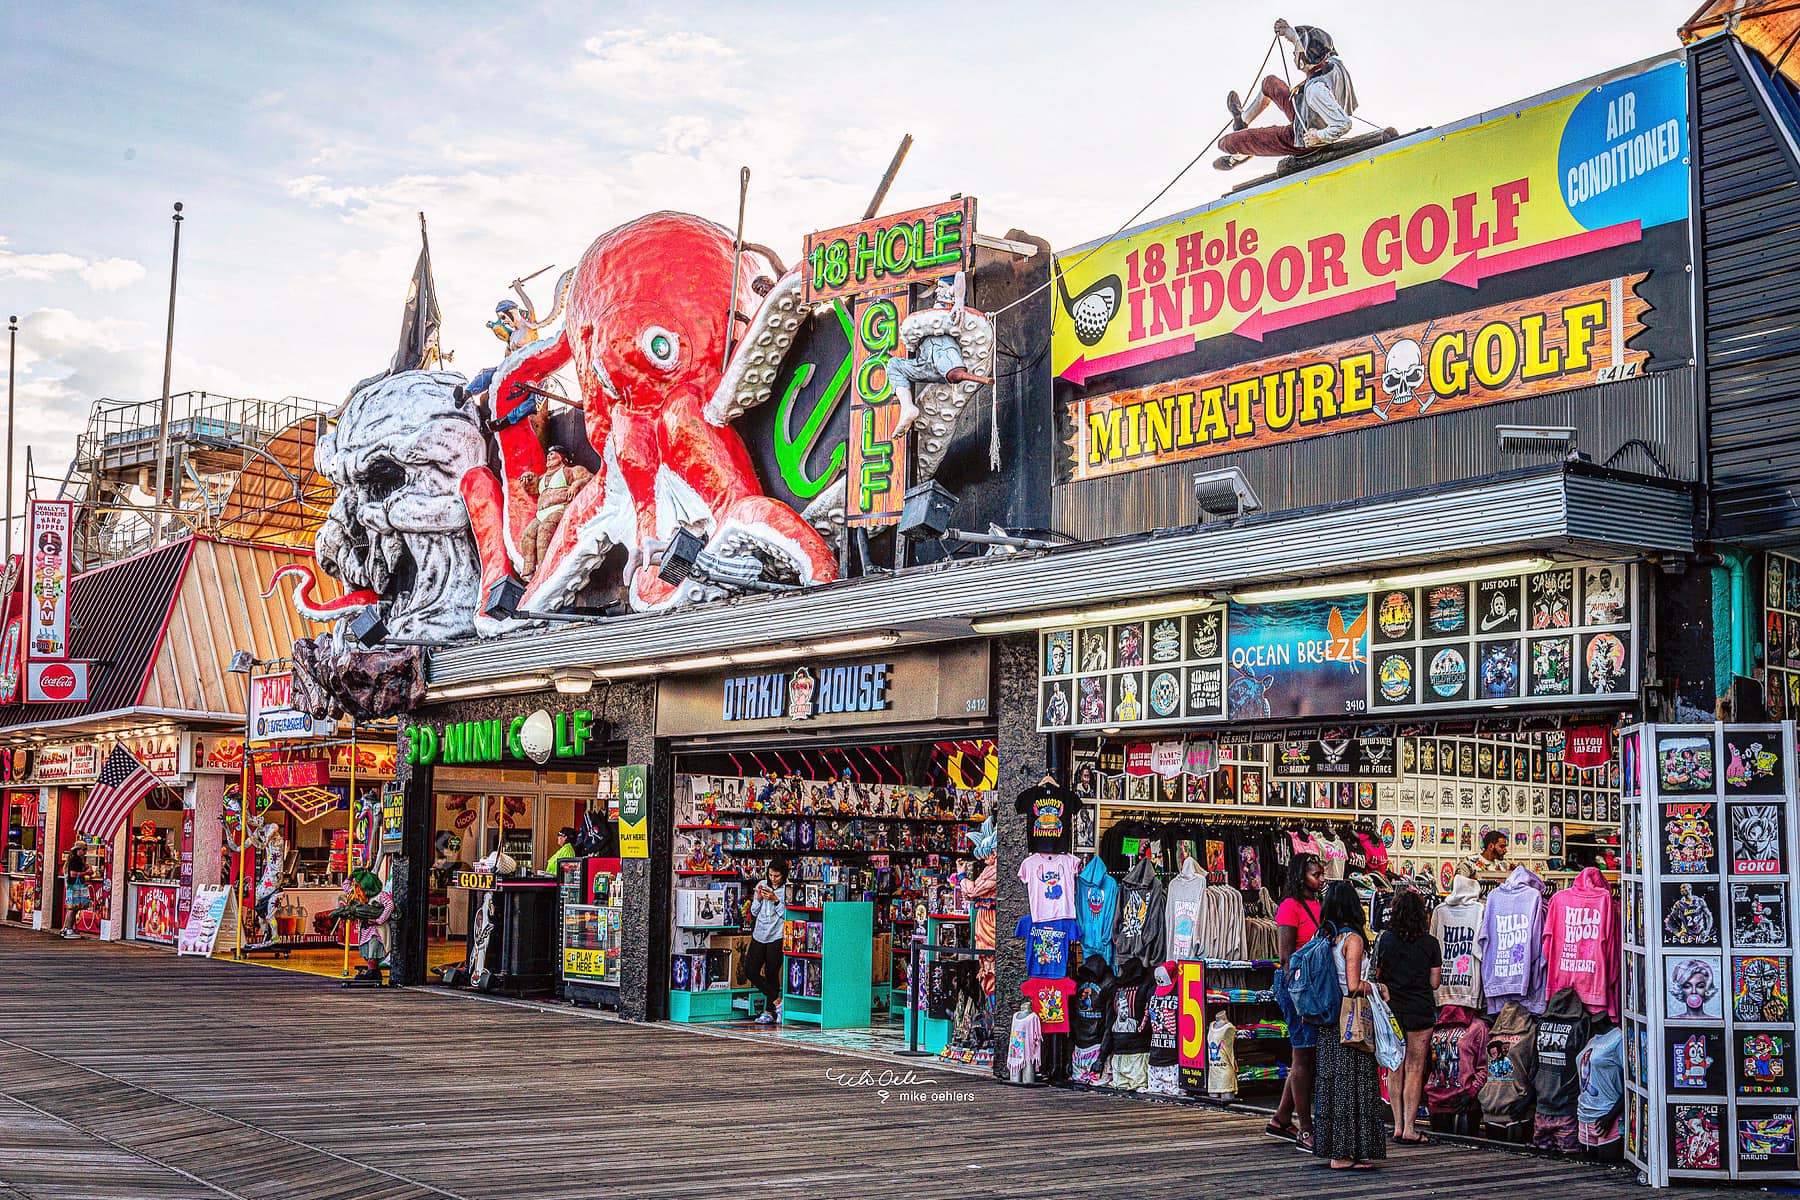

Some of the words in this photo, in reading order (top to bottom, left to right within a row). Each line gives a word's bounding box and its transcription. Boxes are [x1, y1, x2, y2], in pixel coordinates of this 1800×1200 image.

[1606, 92, 1637, 142] AIR
[1567, 118, 1680, 208] CONDITIONED
[809, 239, 849, 290] 18
[855, 210, 962, 281] HOLE
[1126, 243, 1166, 289] 18
[1175, 220, 1259, 274] Hole
[1127, 233, 1349, 342] INDOOR
[1361, 177, 1530, 274] GOLF
[1089, 351, 1376, 466] MINIATURE
[1430, 300, 1608, 398] GOLF
[859, 298, 898, 513] GOLF
[1480, 580, 1497, 590] JUST
[1497, 579, 1510, 590] DO
[1510, 578, 1518, 588] IT.
[1531, 571, 1572, 593] SAVAGE
[51, 642, 64, 650] TEA
[1231, 641, 1290, 668] OCEAN
[1297, 637, 1367, 664] BREEZE
[722, 673, 785, 721] OTAKU
[818, 664, 887, 714] HOUSE
[965, 698, 986, 713] 3412
[1345, 699, 1365, 711] 3410
[405, 724, 438, 765] 3D
[443, 719, 503, 765] MINI
[206, 760, 220, 768] ICE
[221, 760, 243, 769] CREA
[329, 765, 367, 774] PIZZRIA
[1359, 765, 1371, 774] AIR
[1372, 764, 1393, 774] FORCE
[1666, 803, 1711, 817] LUFFY
[456, 811, 477, 827] Hood
[620, 833, 632, 841] PLAY
[1737, 861, 1776, 872] GOKU
[460, 873, 494, 889] GOLF
[1495, 914, 1529, 933] WILD
[1565, 905, 1601, 926] WILD
[1443, 925, 1475, 943] WILD
[1497, 931, 1528, 951] WOOD
[1564, 924, 1599, 944] WOOD
[576, 951, 593, 962] PLAY
[1443, 941, 1473, 960] WOOD
[576, 961, 592, 973] HERE
[1560, 958, 1575, 972] NEW
[1450, 974, 1473, 987] JERSEY
[1182, 963, 1203, 1059] 5
[1150, 1038, 1176, 1049] FALLEN
[1191, 1068, 1202, 1077] Table
[1187, 1077, 1198, 1086] Only
[1738, 1085, 1763, 1093] SUPER
[1763, 1085, 1790, 1093] MARIO
